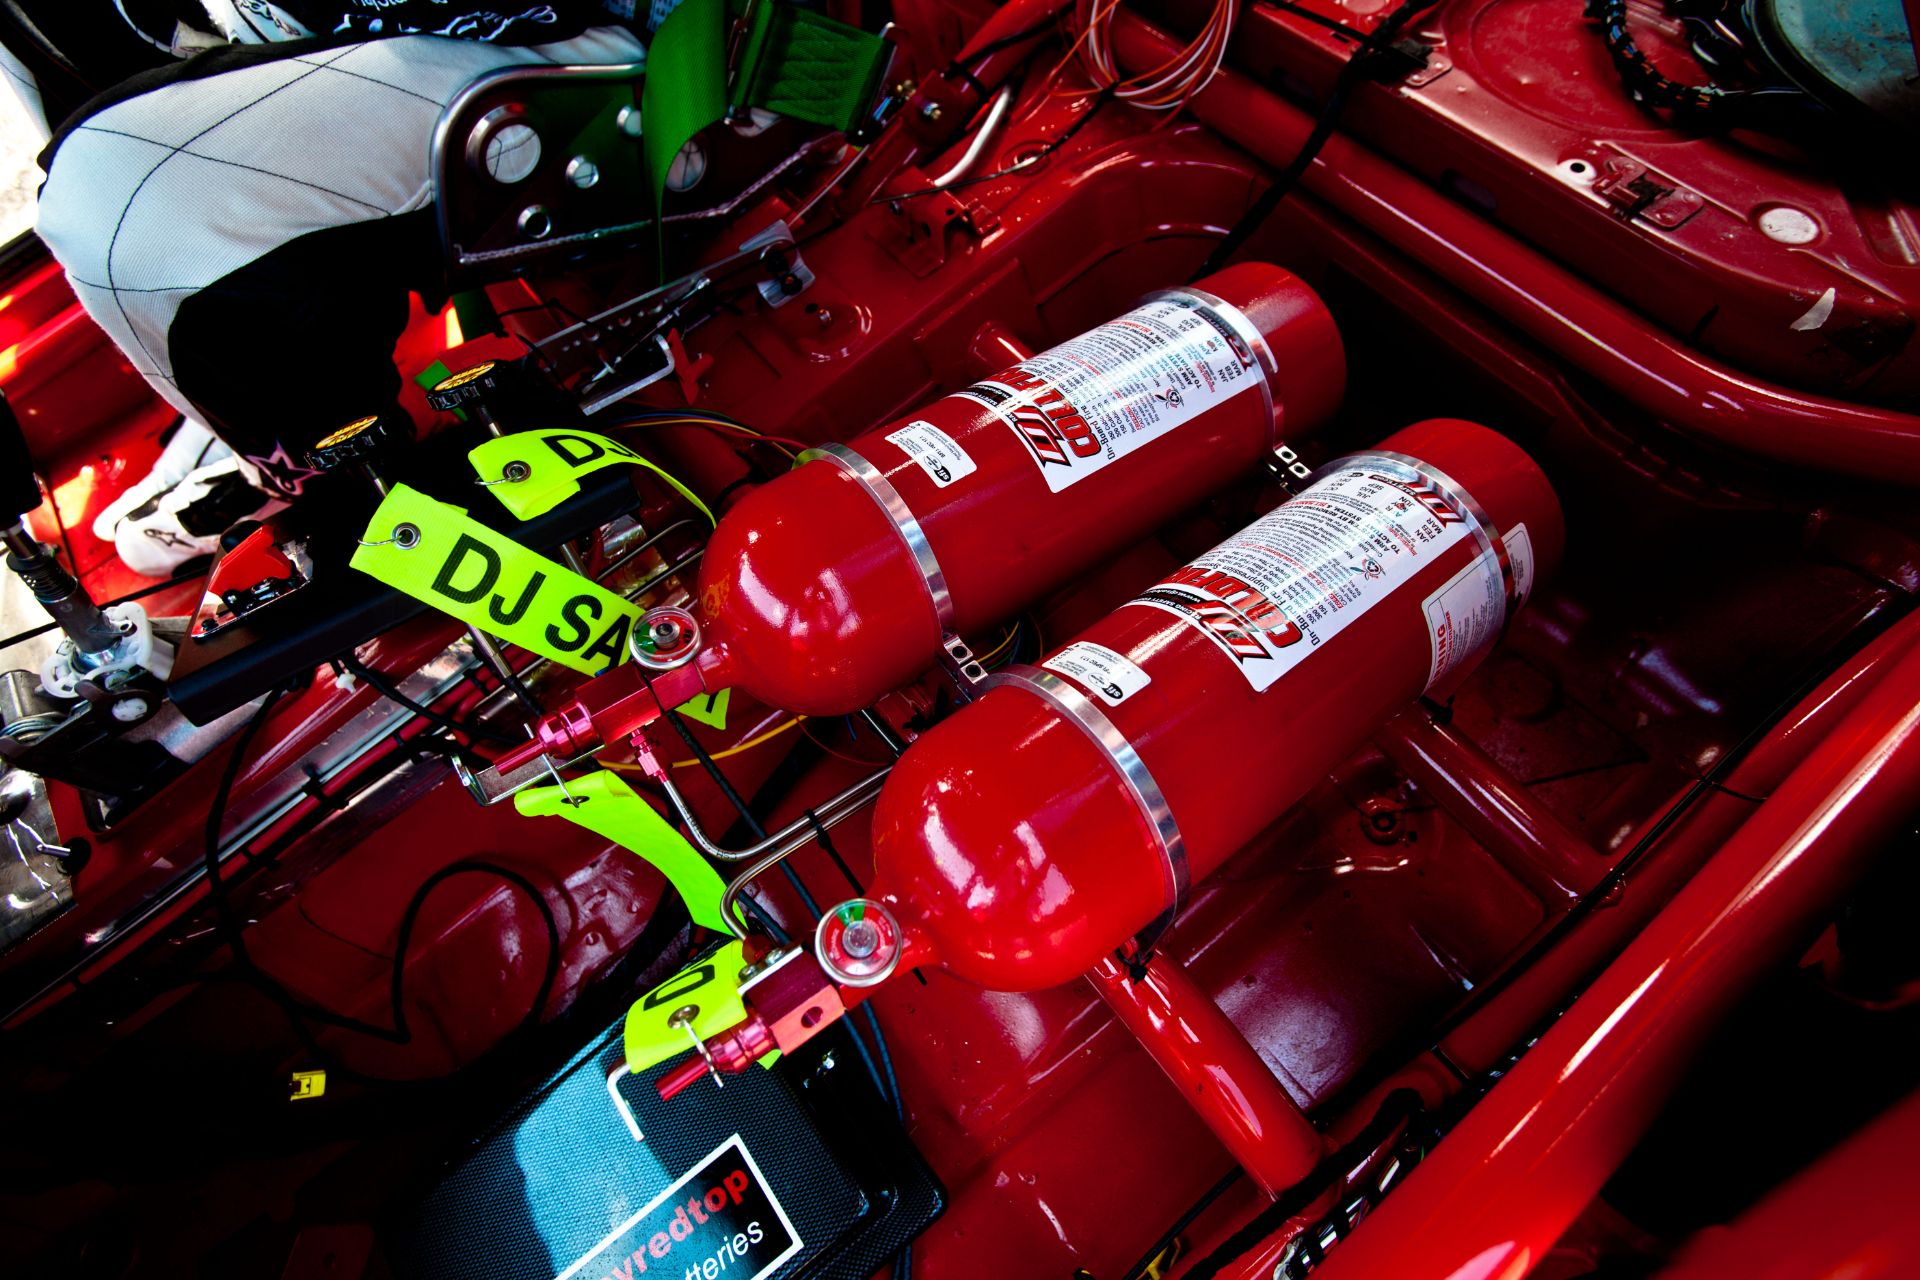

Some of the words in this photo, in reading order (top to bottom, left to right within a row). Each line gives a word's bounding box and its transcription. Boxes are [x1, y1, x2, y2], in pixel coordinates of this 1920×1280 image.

[1175, 322, 1189, 333] JUL
[1180, 318, 1196, 330] AUG
[1128, 326, 1157, 346] REMOVING
[1211, 335, 1225, 348] JUN
[1173, 352, 1197, 379] ACTUATE
[1222, 364, 1237, 380] FEB
[1228, 359, 1244, 376] MAR
[1170, 371, 1187, 390] Contact
[1180, 371, 1193, 386] ARM
[1216, 368, 1230, 384] JAN
[1042, 372, 1083, 406] Suppresion
[1192, 378, 1203, 389] TO
[989, 366, 1098, 457] COLFIR
[1076, 404, 1094, 421] Fire
[1108, 409, 1123, 425] Cubic
[1097, 415, 1111, 431] Cubic
[1103, 412, 1117, 428] Cubic
[1106, 429, 1117, 441] 350
[1112, 426, 1122, 438] 300
[1118, 423, 1128, 434] 150
[1088, 419, 1116, 460] On-Board
[936, 468, 950, 480] sfi
[1357, 485, 1378, 495] AUG
[1366, 481, 1385, 491] SEP
[1353, 490, 1371, 500] JUL
[1397, 495, 1416, 508] JUN
[1384, 504, 1402, 518] AR
[1390, 499, 1409, 513] MY
[1330, 505, 1362, 523] SYSTEM,
[1336, 514, 1349, 522] BY
[1419, 523, 1437, 540] FEB
[1424, 516, 1443, 535] MAR
[1413, 528, 1430, 545] JAN
[1363, 539, 1384, 558] Contact
[1373, 537, 1390, 552] ARM
[1389, 543, 1402, 555] TO
[1218, 564, 1271, 592] Suppression
[1265, 569, 1286, 583] Empty
[1271, 564, 1292, 579] Empty
[431, 533, 547, 626] DJ
[1260, 573, 1280, 587] Empty
[1291, 579, 1307, 592] Inch
[1279, 588, 1295, 600] Inch
[1285, 583, 1301, 596] Inch
[1345, 586, 1358, 599] eyes
[1266, 589, 1287, 606] Fire
[1343, 592, 1353, 602] and
[1316, 603, 1330, 615] 150
[1326, 600, 1338, 612] Best
[1304, 611, 1317, 624] 350
[1310, 607, 1323, 620] 300
[1188, 597, 1273, 665] DJ
[1105, 684, 1121, 697] sfi
[642, 954, 717, 1012] D
